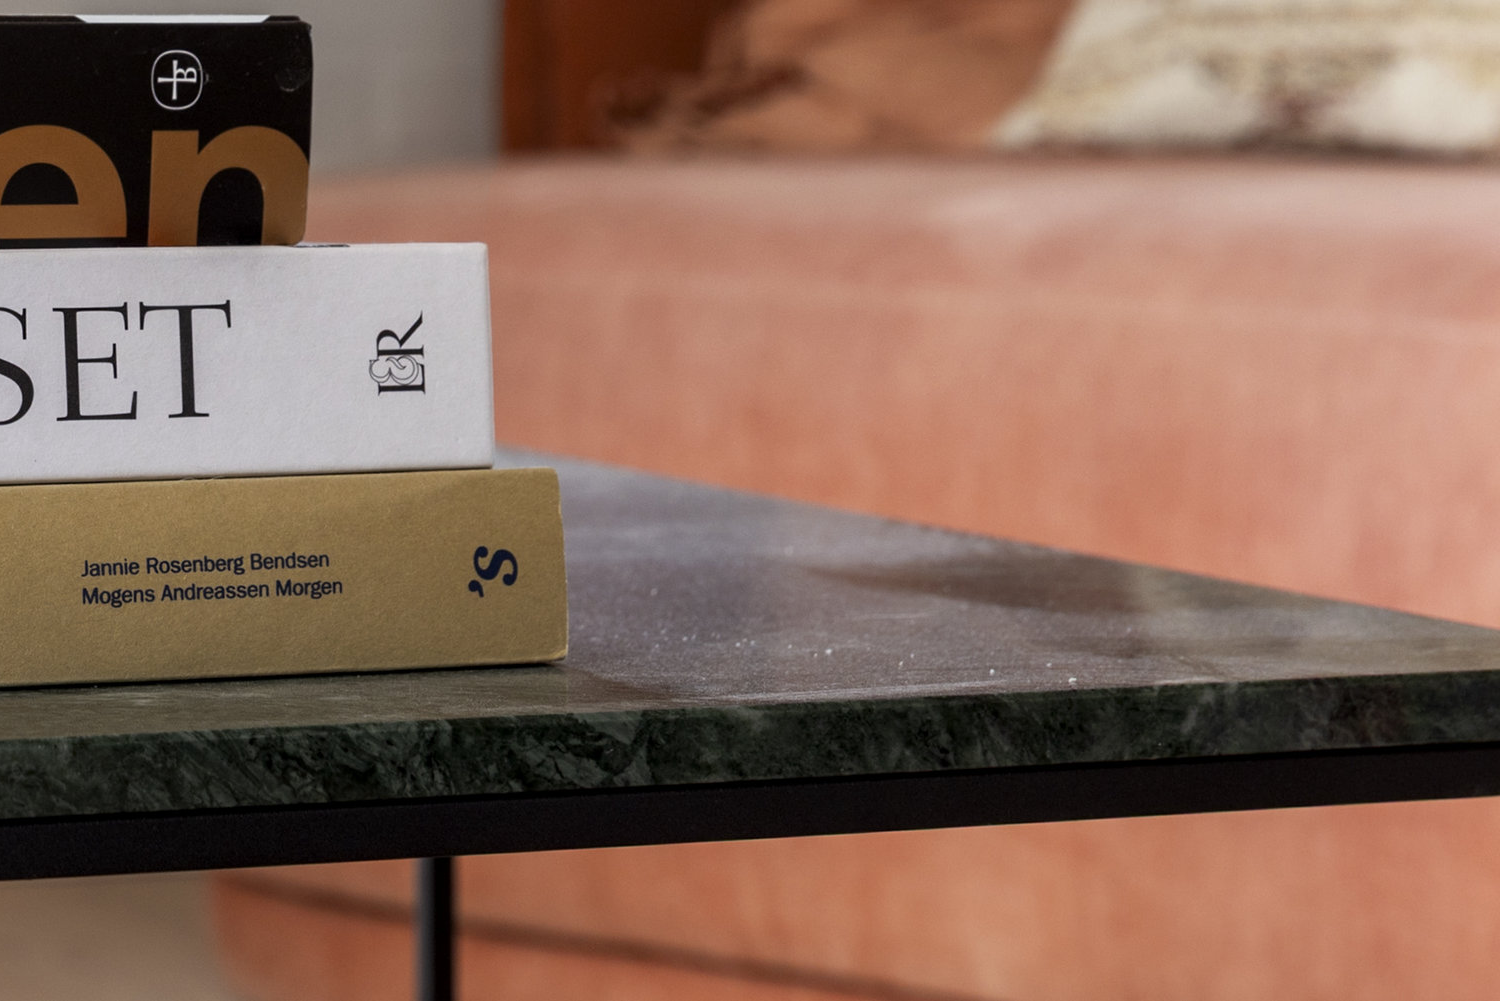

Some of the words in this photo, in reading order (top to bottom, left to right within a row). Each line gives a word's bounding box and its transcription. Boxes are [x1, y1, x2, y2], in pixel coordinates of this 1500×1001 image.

[81, 558, 140, 577] Jannie
[145, 555, 246, 575] Rosenberg
[250, 552, 330, 571] Bendsen
[82, 587, 156, 608] Mogens
[160, 583, 270, 601] Andreassen
[275, 579, 343, 600] Morgen
